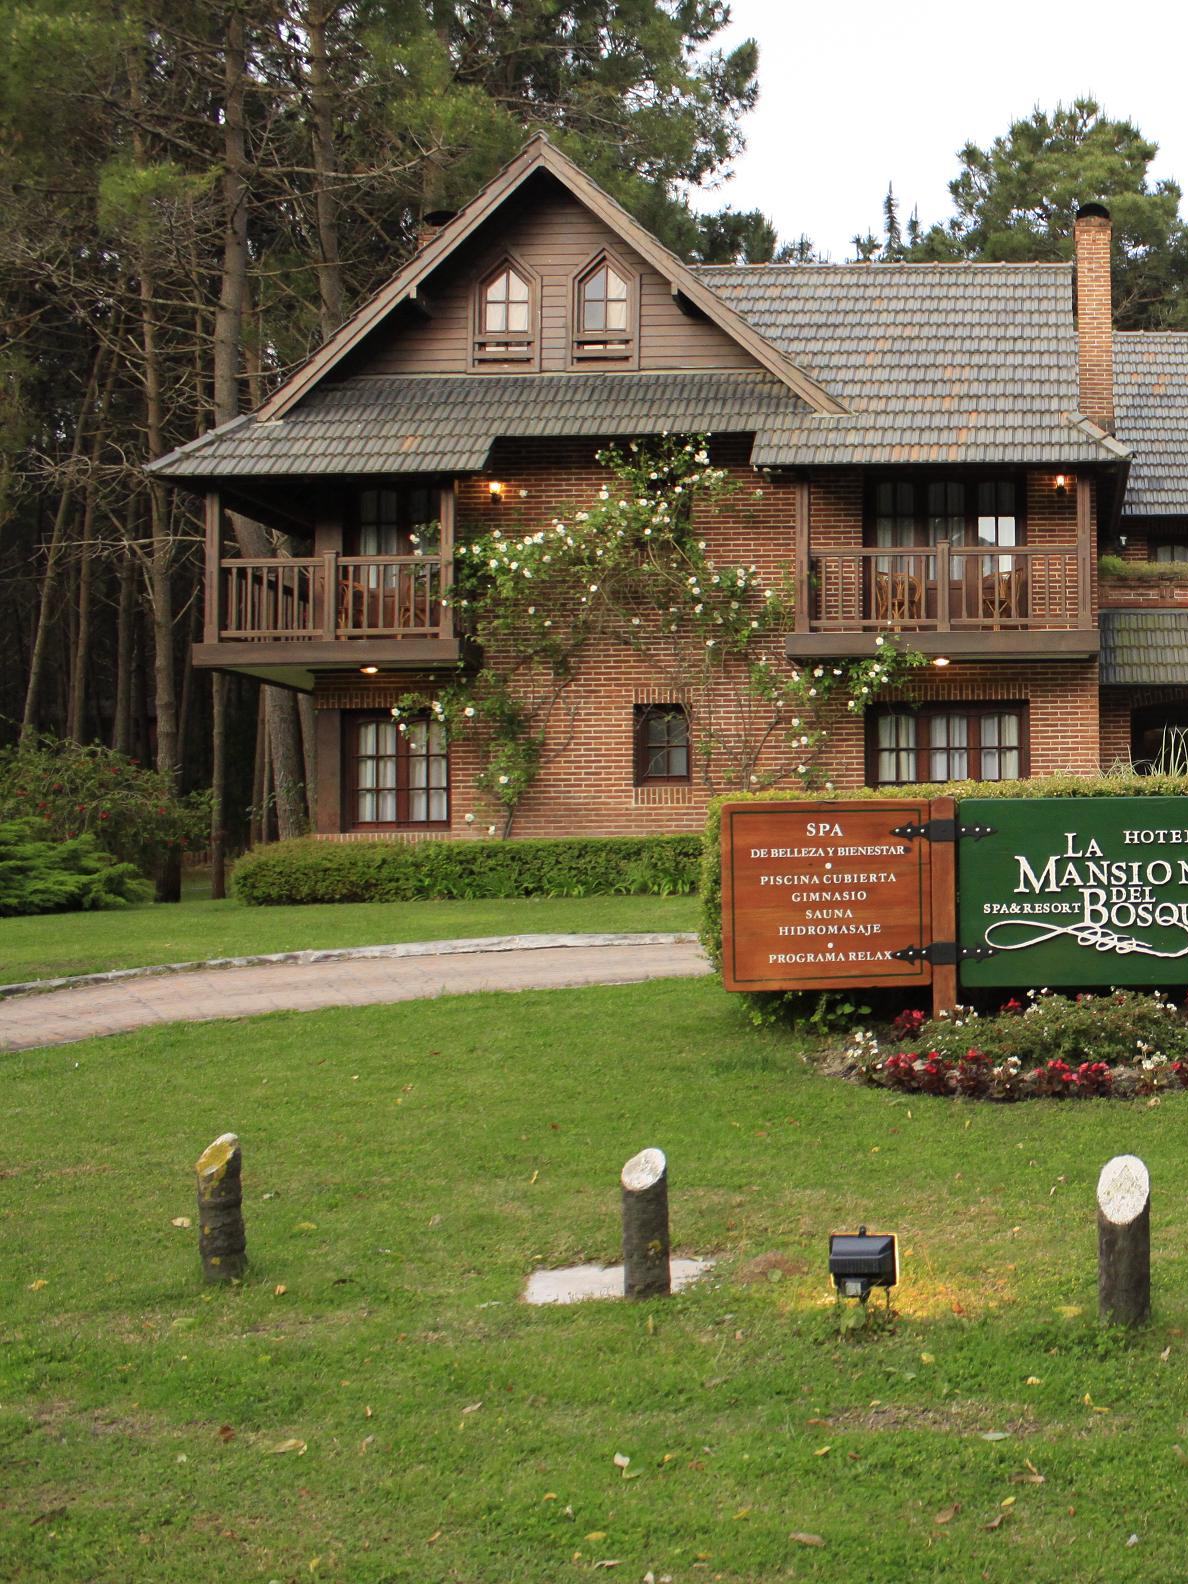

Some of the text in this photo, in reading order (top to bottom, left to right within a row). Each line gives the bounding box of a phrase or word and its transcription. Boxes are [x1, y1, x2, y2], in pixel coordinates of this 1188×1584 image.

[806, 823, 844, 837] SPA
[750, 845, 905, 858] DE BELLEZA Y BIENESTAR
[1063, 832, 1104, 858] LA
[760, 873, 896, 886] PISCINA CUBIERTA
[791, 890, 867, 902] GIMNASIO
[1109, 886, 1156, 903] DEL
[805, 909, 854, 920] SAUNA
[779, 924, 882, 936] HIDROMASAJE
[768, 950, 893, 964] PROGRAMA RELAX
